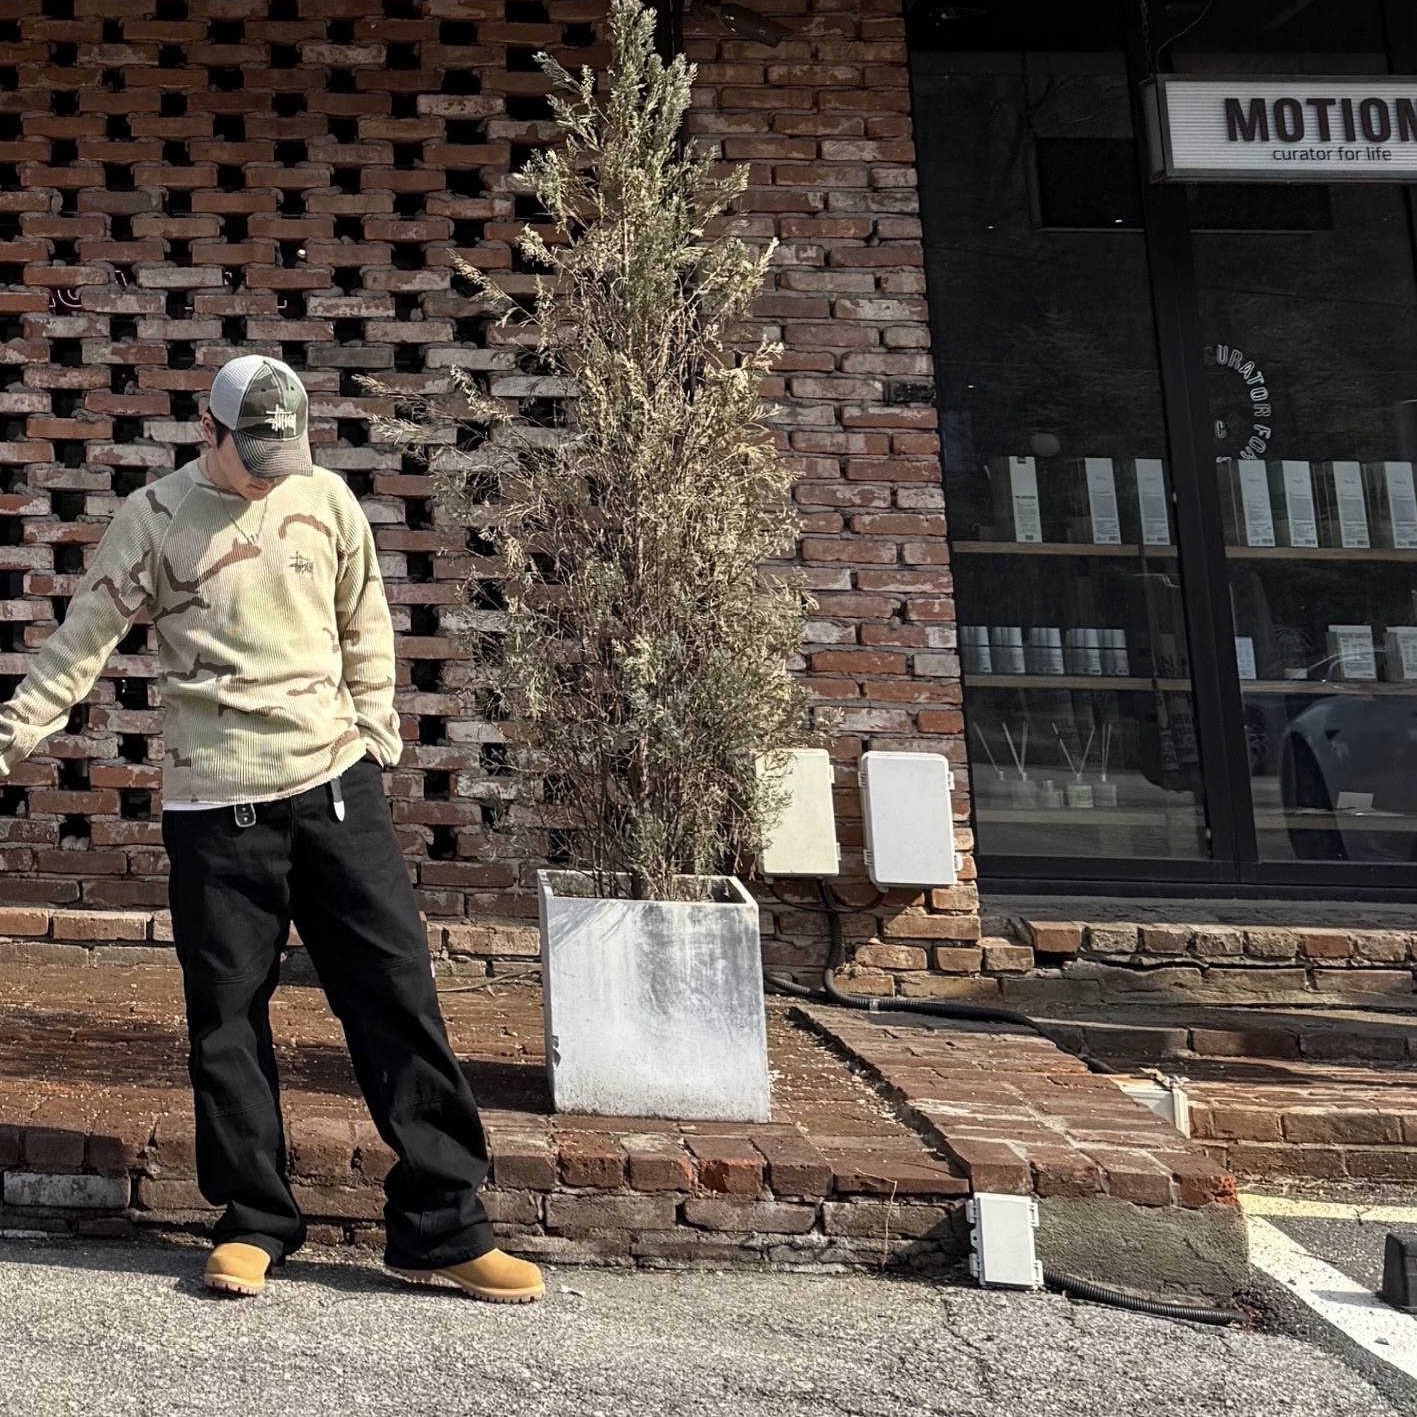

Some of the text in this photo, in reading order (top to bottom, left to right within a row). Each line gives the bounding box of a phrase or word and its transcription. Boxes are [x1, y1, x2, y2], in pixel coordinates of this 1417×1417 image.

[1272, 146, 1392, 161] curator for life
